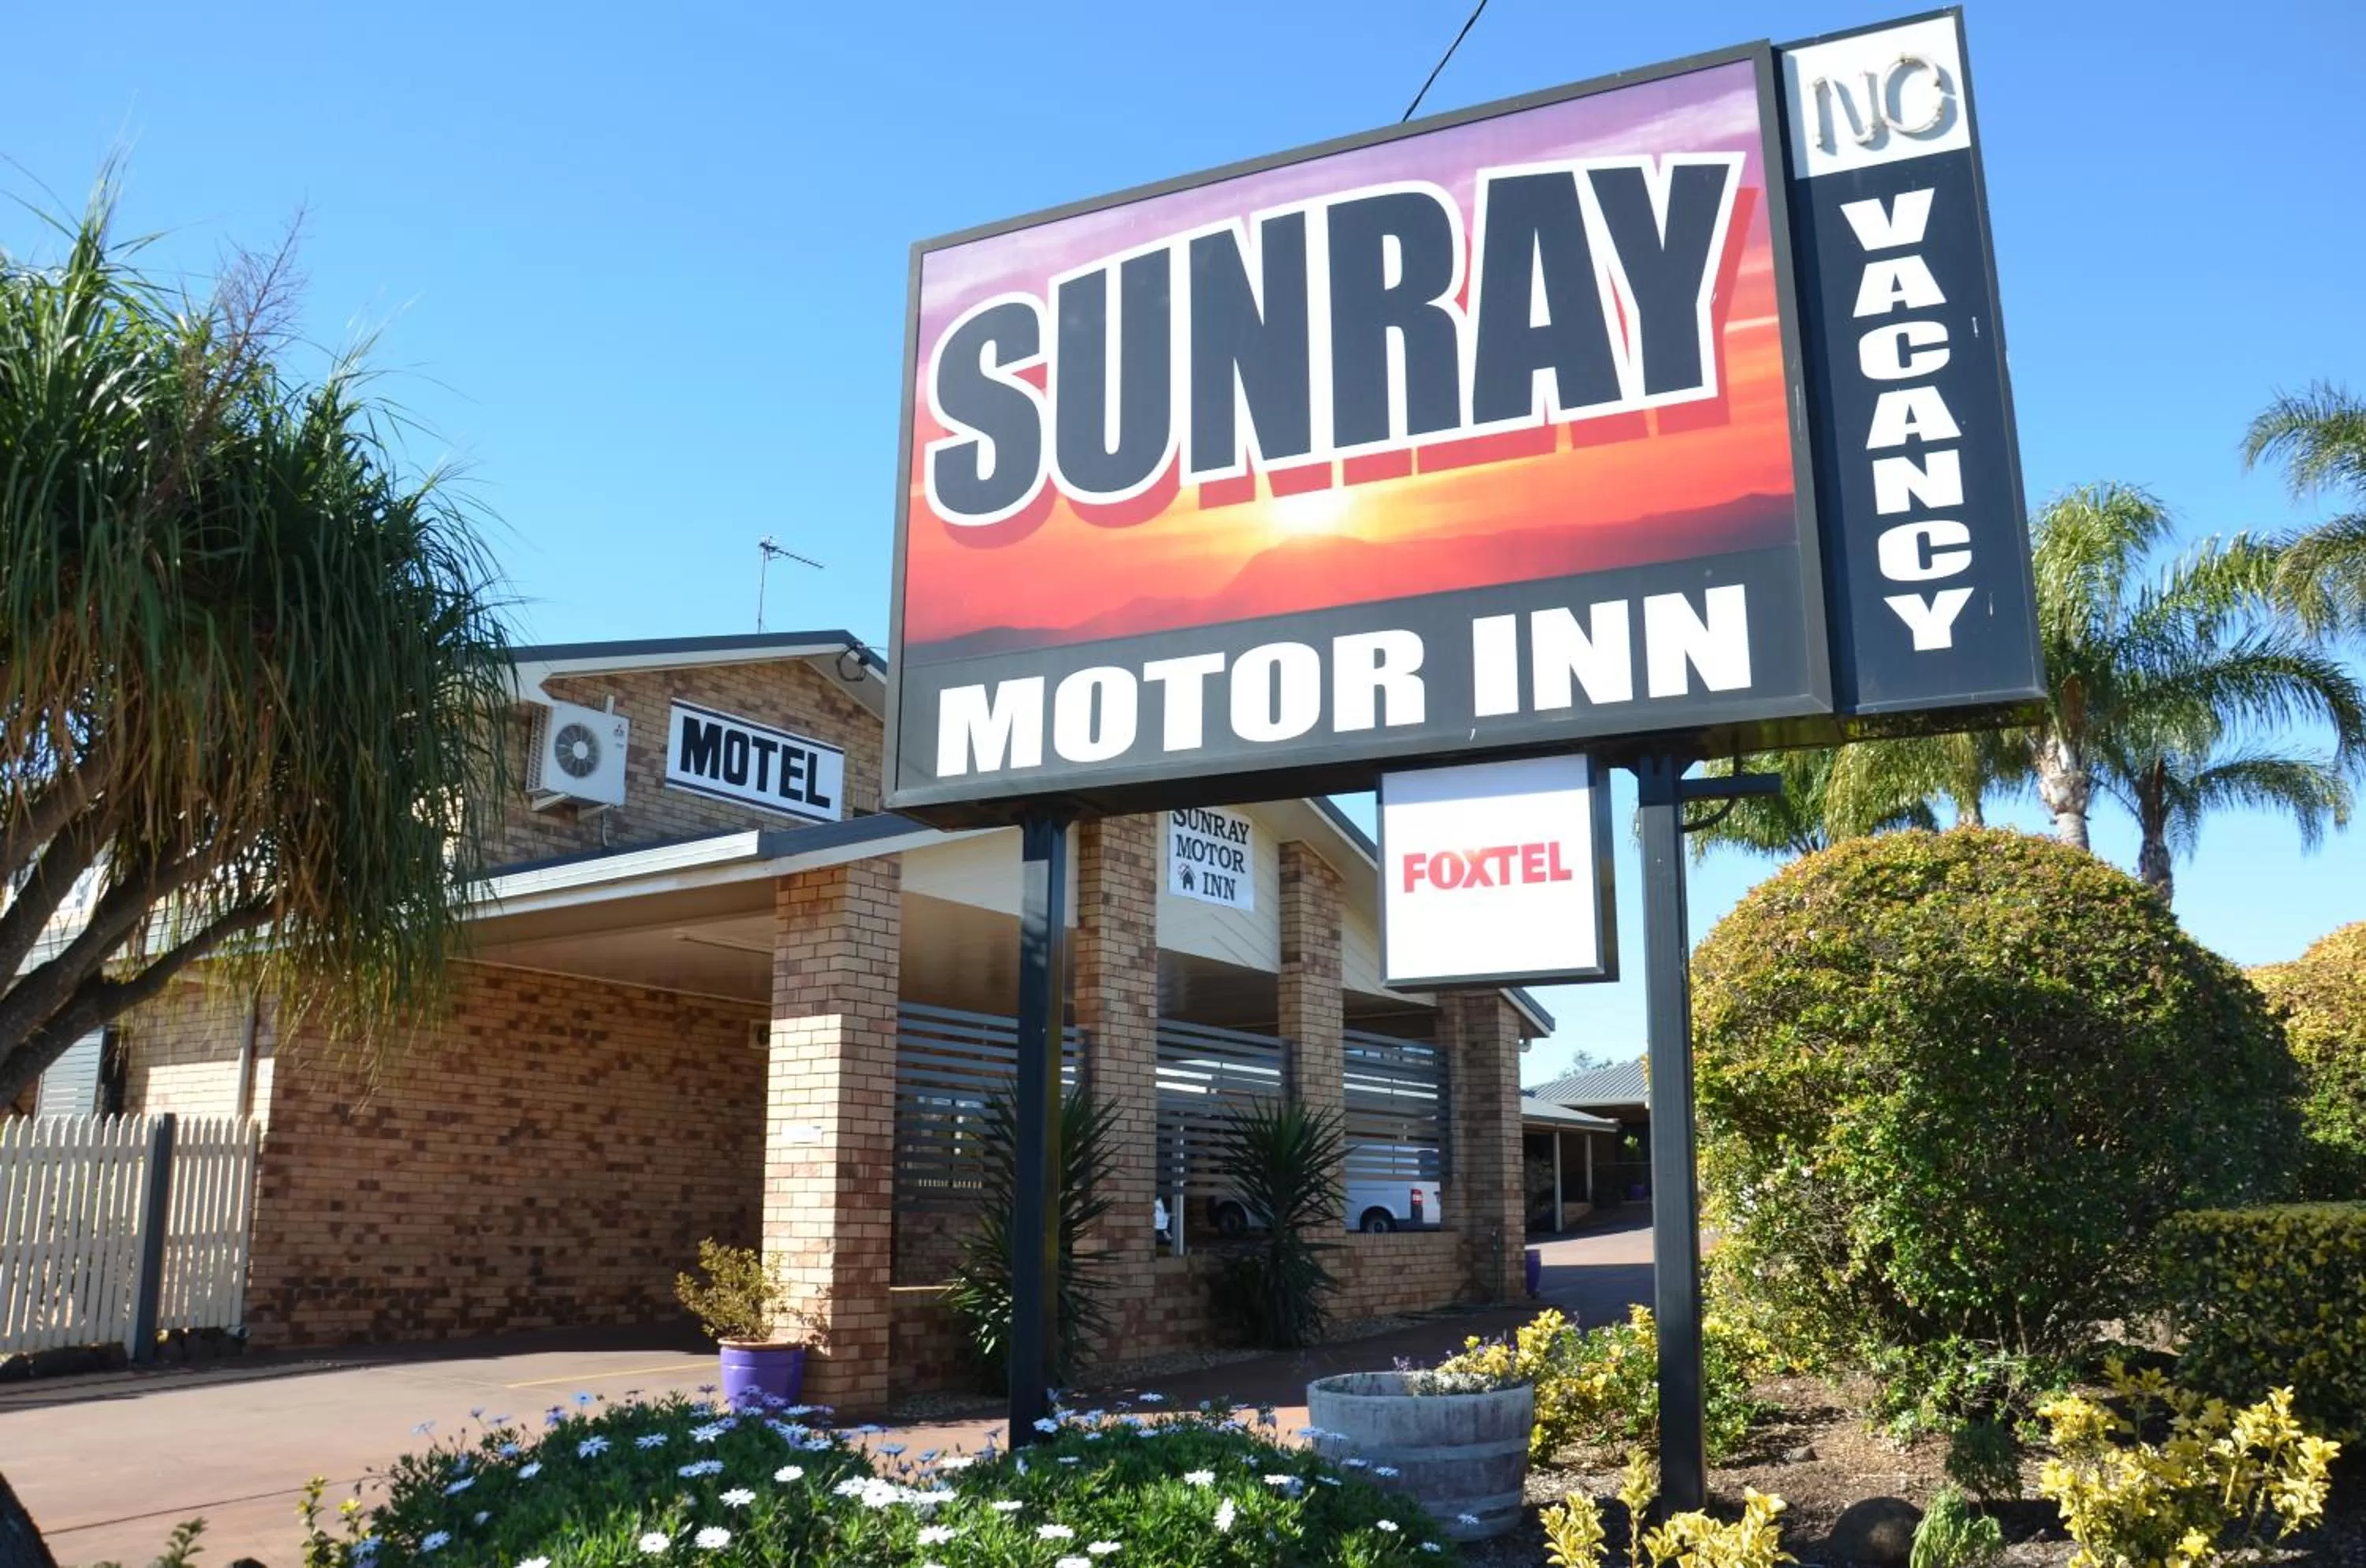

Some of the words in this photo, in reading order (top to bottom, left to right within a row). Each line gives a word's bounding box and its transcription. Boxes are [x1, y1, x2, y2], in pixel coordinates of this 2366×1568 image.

[1810, 52, 1945, 148] NO
[925, 151, 1746, 526] SUNRAY
[1840, 188, 1974, 651] VACANCY
[935, 629, 1424, 777] MOTOR
[1472, 584, 1752, 717] INN
[680, 715, 830, 808] MOTEL
[1172, 808, 1250, 845] SUNRAY
[1176, 834, 1246, 874] MOTOR
[1403, 842, 1573, 893] FOXTEL
[1203, 872, 1237, 901] INN
